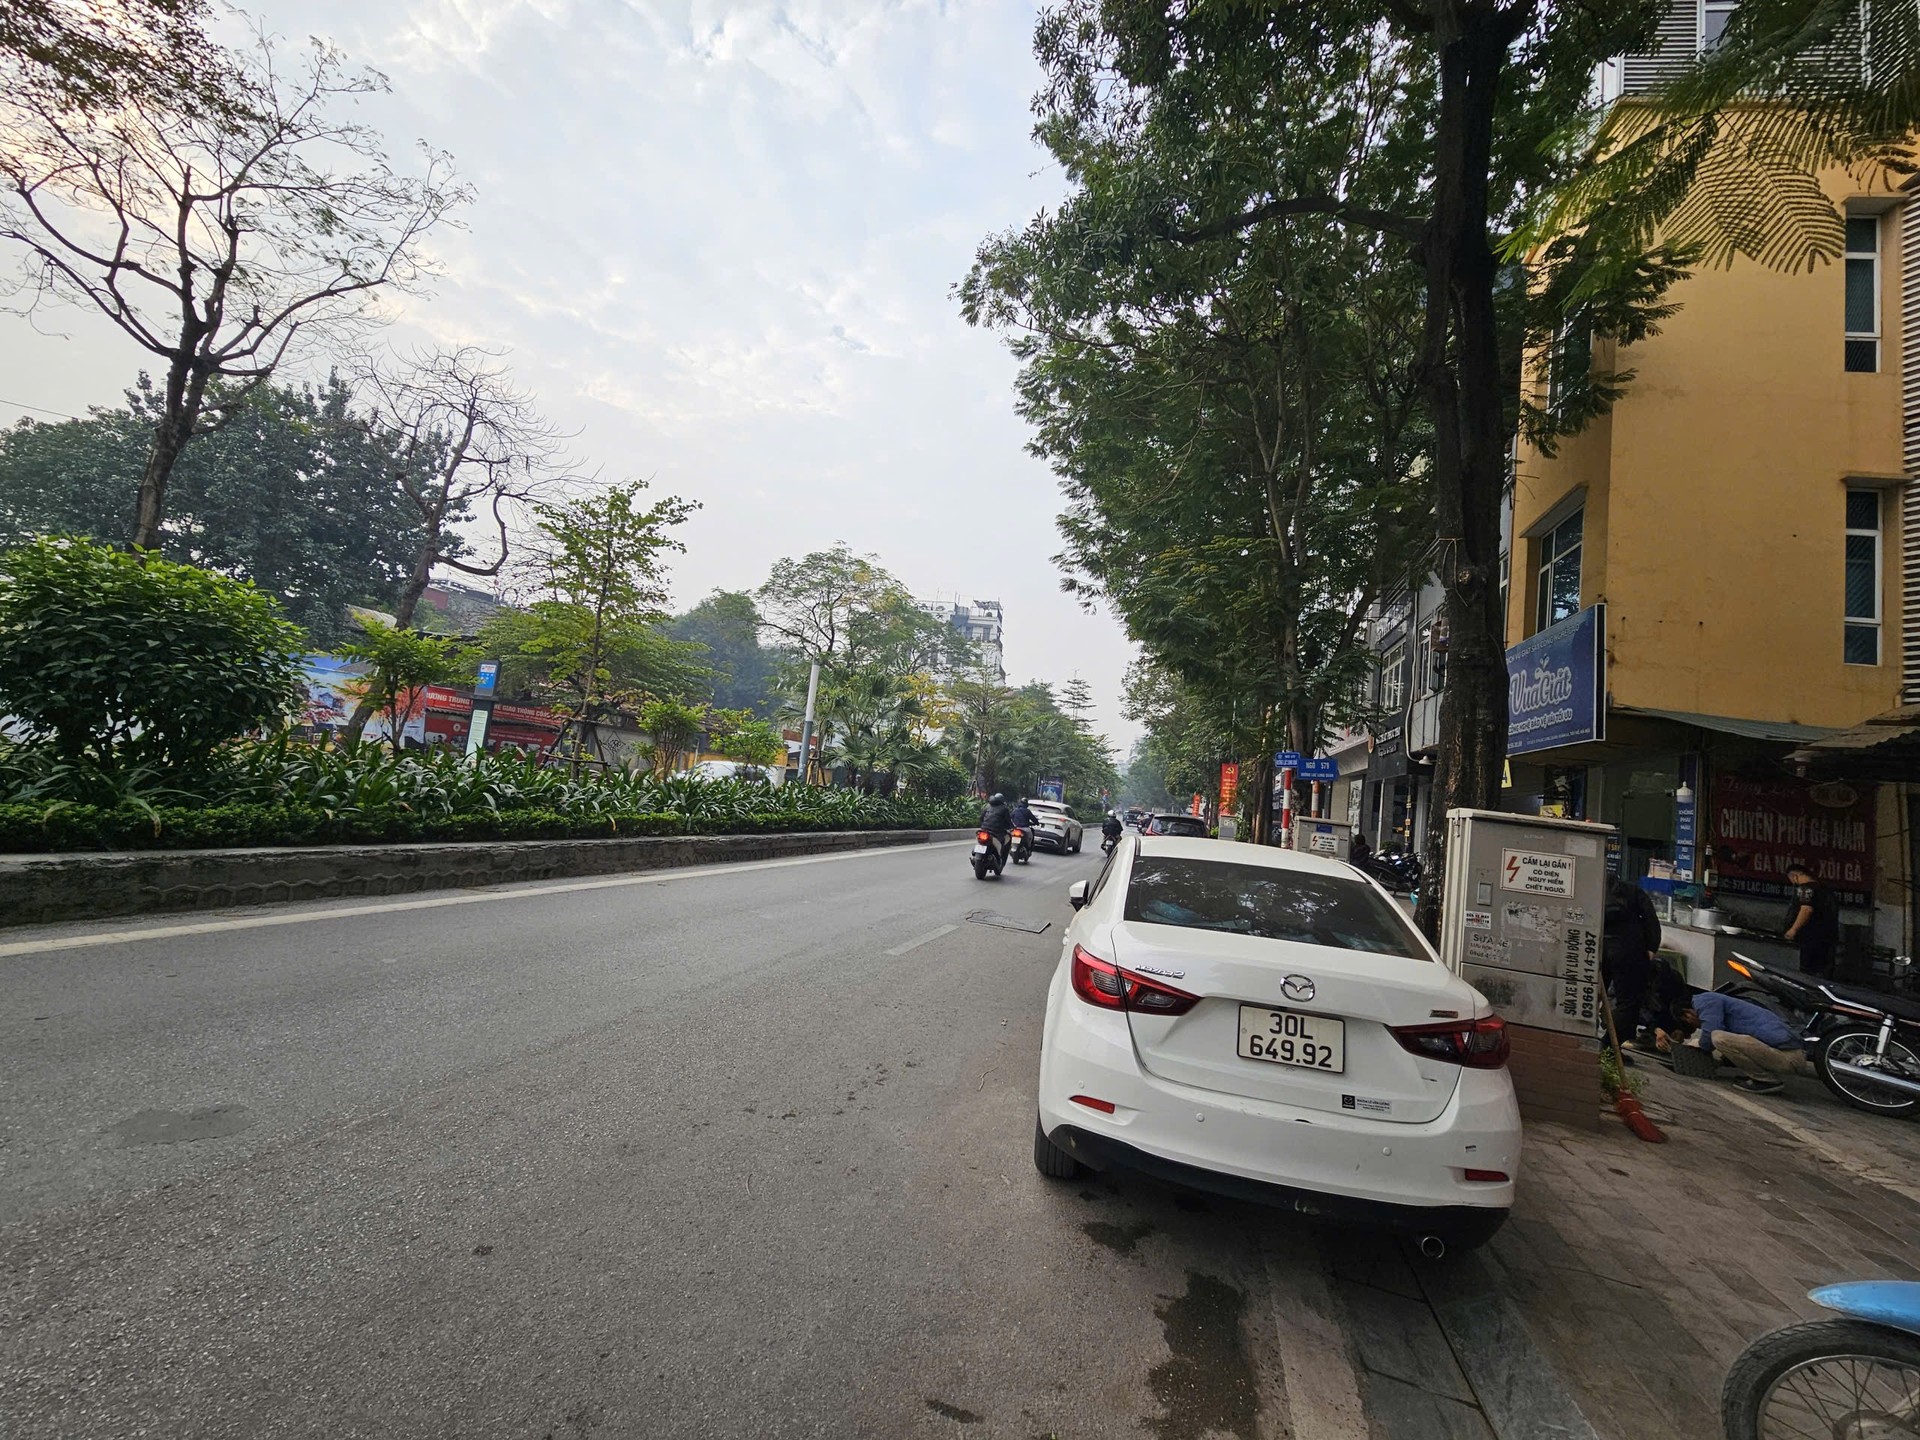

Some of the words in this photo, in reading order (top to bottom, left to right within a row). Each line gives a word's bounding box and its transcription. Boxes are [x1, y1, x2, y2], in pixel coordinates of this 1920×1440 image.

[449, 695, 469, 705] TRUNG
[1720, 806, 1774, 843] CHUYÊN
[1777, 809, 1806, 847] PHỞ
[1522, 856, 1538, 866] CẤM
[1540, 859, 1550, 869] LẠI
[1818, 856, 1840, 881] XÔI
[1844, 859, 1863, 882] GÀ
[1544, 870, 1560, 878] ĐIỆN
[1547, 878, 1564, 886] HIỂM
[1544, 886, 1566, 894] NGƯỜI
[1564, 928, 1582, 951] ĐỘNG
[1565, 951, 1579, 968] LƯU
[1562, 968, 1578, 985] MÁY
[1564, 986, 1578, 999] XE
[1559, 1000, 1577, 1016] SỬA
[1269, 1013, 1314, 1040] 30L
[1250, 1034, 1332, 1069] 649.92
